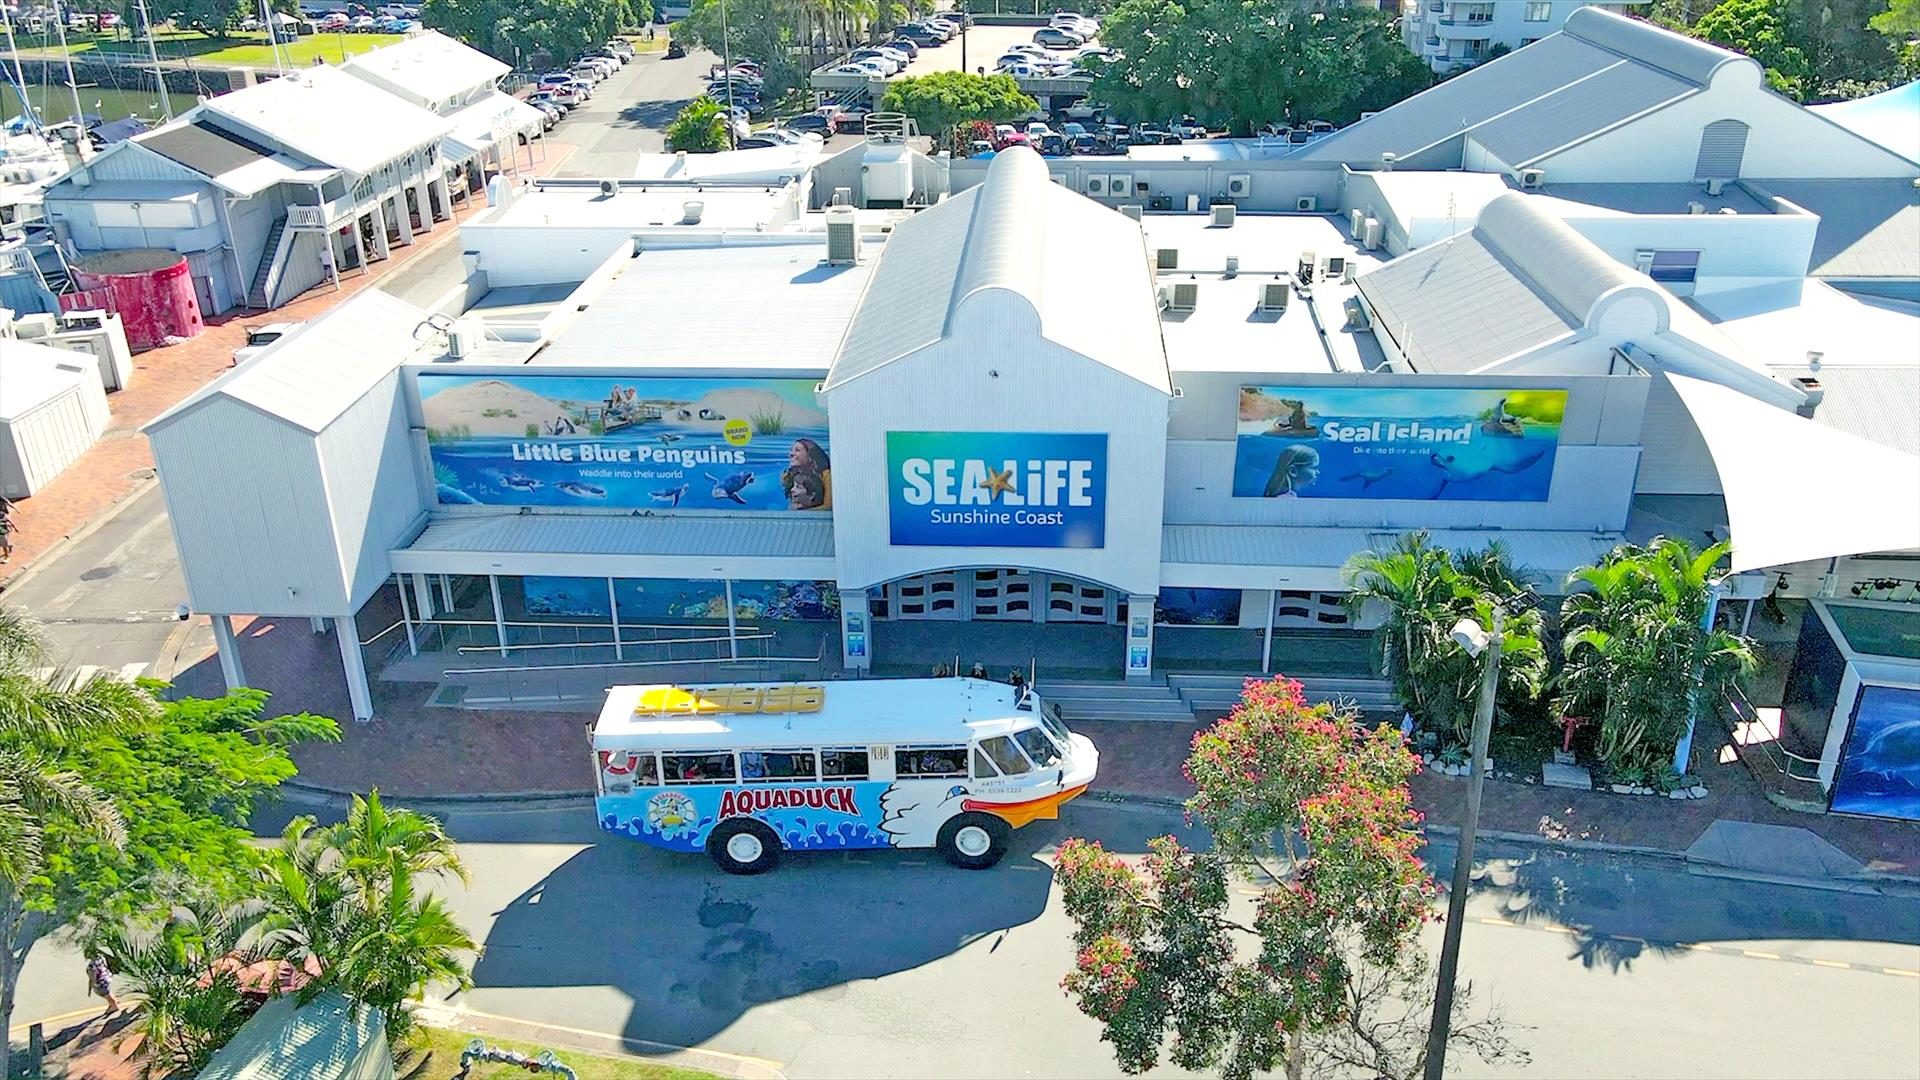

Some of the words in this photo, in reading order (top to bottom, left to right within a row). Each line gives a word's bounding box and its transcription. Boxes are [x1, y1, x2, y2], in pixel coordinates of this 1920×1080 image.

[1323, 421, 1380, 442] Seal
[1387, 422, 1472, 444] Island
[512, 443, 573, 461] Little
[580, 444, 631, 462] Blue
[638, 446, 746, 468] Penguins
[579, 469, 613, 478] Waddle
[614, 469, 632, 478] into
[633, 470, 654, 479] their
[655, 470, 683, 479] world
[902, 458, 992, 505] SEA
[931, 509, 1010, 524] Sunshine
[1015, 510, 1064, 525] Coast
[718, 786, 862, 822] AQUADUCK
